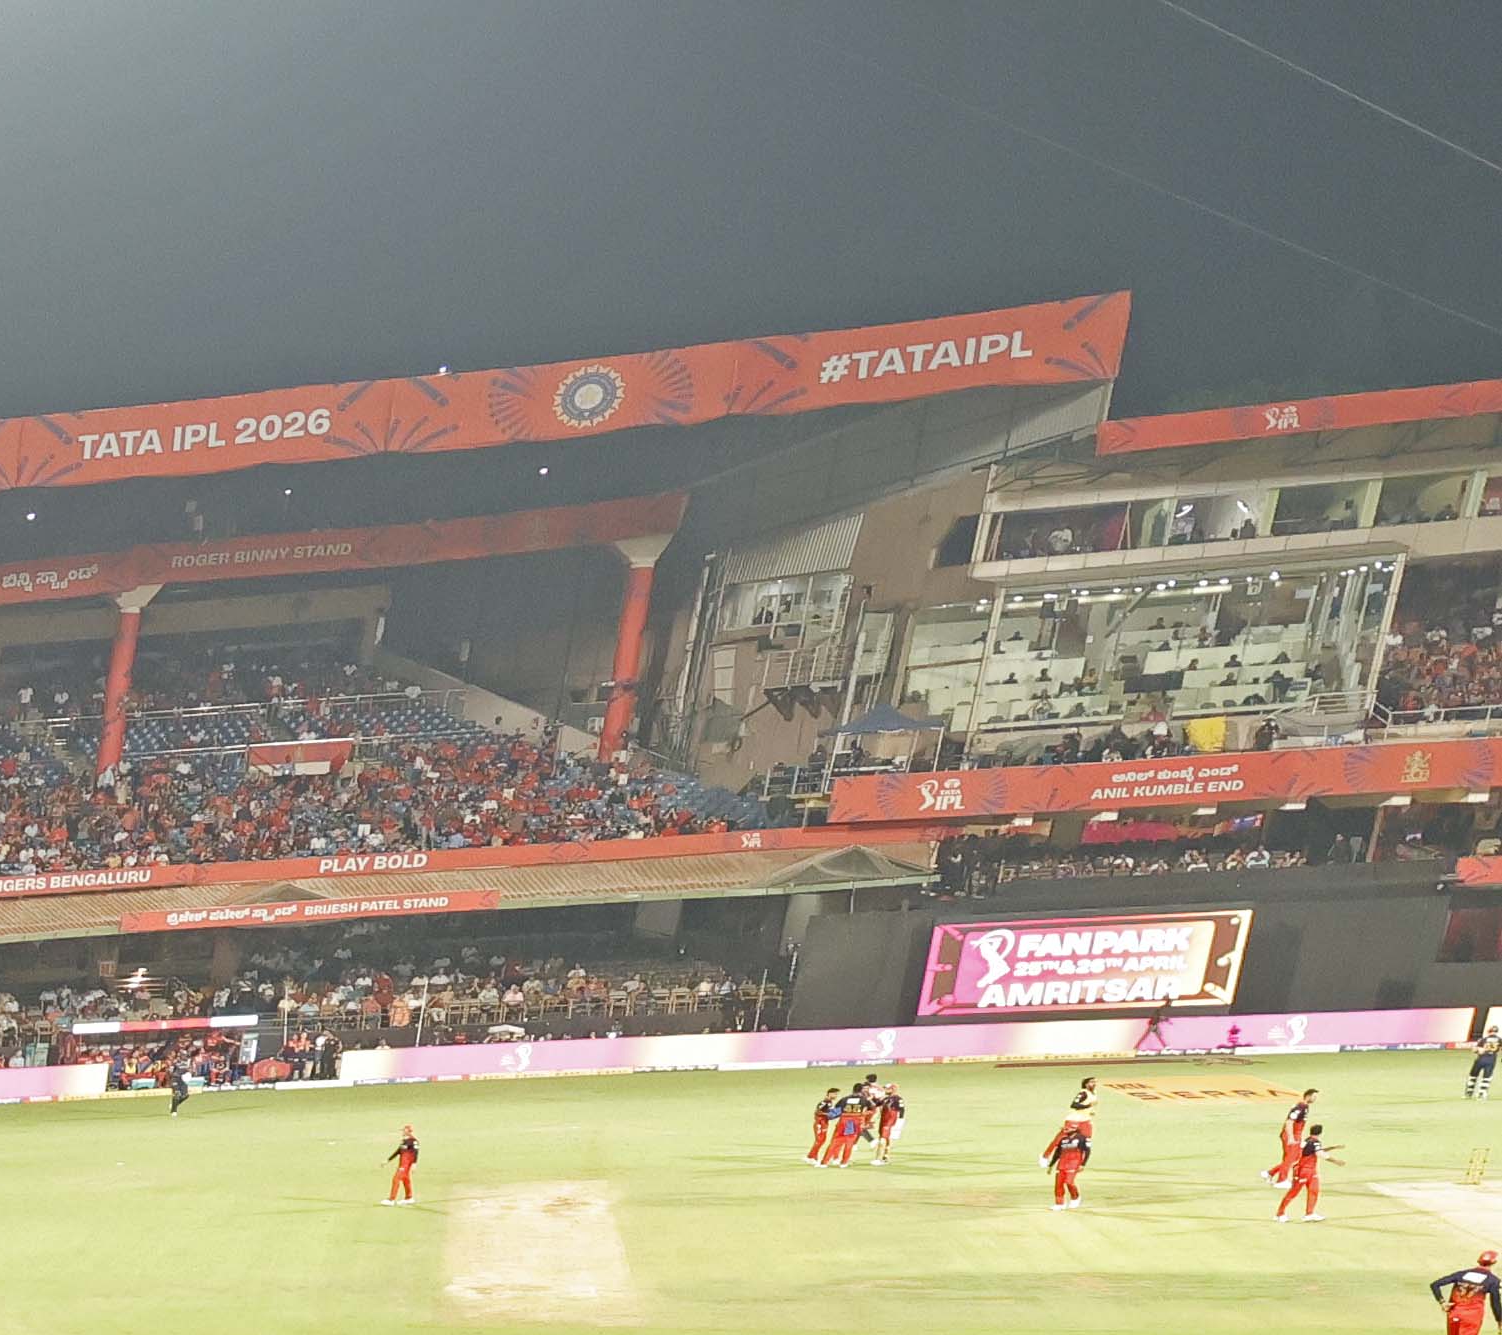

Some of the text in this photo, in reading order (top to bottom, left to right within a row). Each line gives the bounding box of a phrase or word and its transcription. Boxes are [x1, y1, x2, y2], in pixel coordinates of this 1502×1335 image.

[820, 330, 1033, 384] #TATAIPL
[78, 408, 331, 461] TATA IPL 2026
[171, 542, 353, 570] ROGER BINNY STAND
[1090, 779, 1245, 801] ANIL KUMBLE END
[934, 795, 966, 811] IPL
[319, 853, 428, 874] PLAY BOLD
[49, 868, 152, 890] BENGALURU
[304, 897, 449, 915] BRIJESH PATEL STAND
